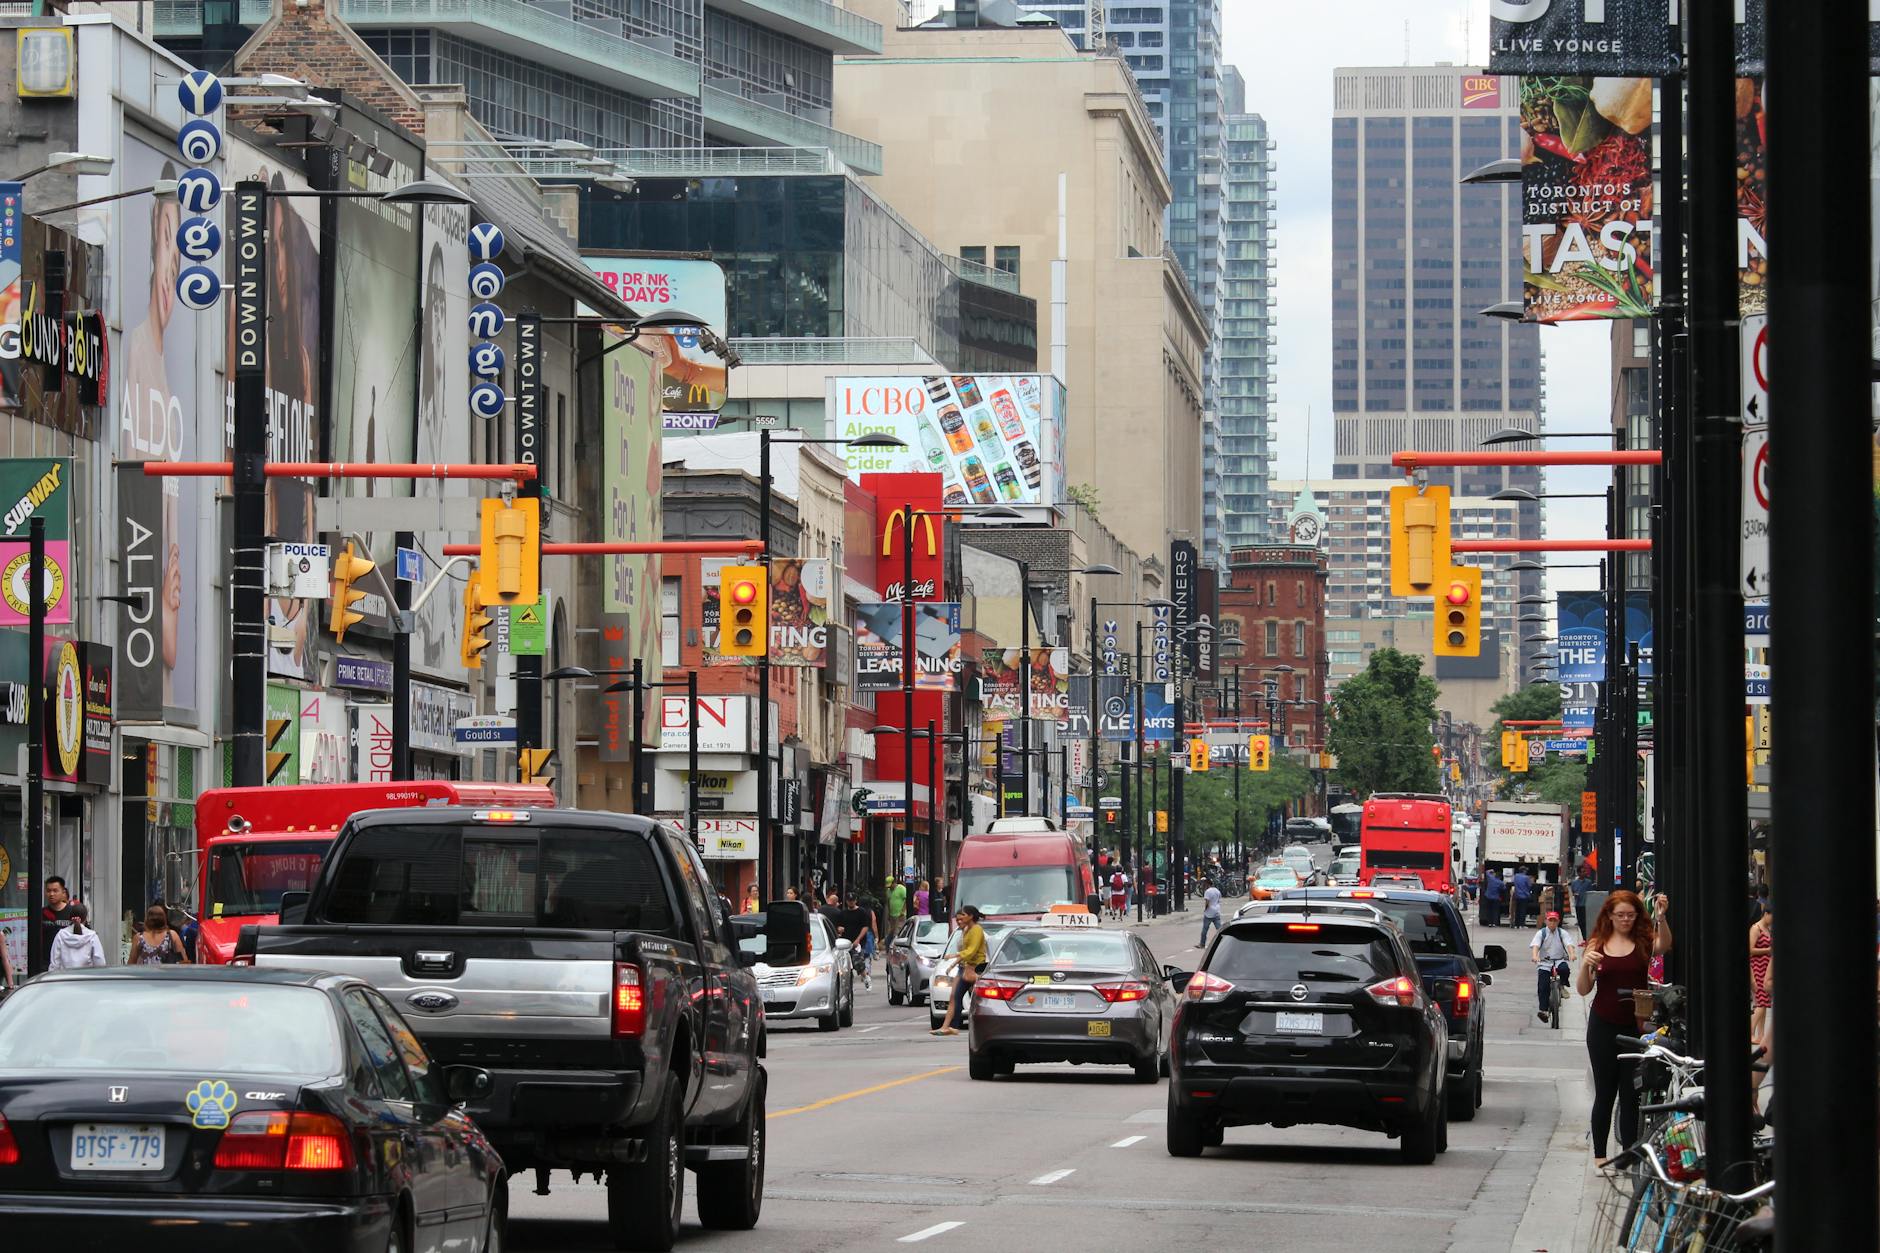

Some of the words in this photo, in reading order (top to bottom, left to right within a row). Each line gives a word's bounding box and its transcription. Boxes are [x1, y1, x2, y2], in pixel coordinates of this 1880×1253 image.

[1500, 40, 1542, 51] LIVE
[1554, 40, 1622, 52] YONGE
[1465, 78, 1496, 91] CIBC
[175, 69, 222, 310] Yonge
[1528, 184, 1631, 199] TORONTO'S
[1529, 200, 1612, 215] DISTRICT
[1620, 200, 1641, 211] OF
[241, 195, 257, 366] DOWNTOWN
[623, 273, 669, 285] DRINK
[623, 287, 670, 303] DAYS
[1530, 294, 1560, 305] LIVE
[1567, 294, 1614, 304] YONGE
[468, 223, 504, 418] Yonge
[522, 325, 534, 463] DOWNTOWN
[613, 359, 635, 425] Drop
[845, 387, 925, 416] LCBO
[122, 379, 183, 463] ALDO
[845, 422, 896, 441] Along
[845, 456, 892, 470] Cider
[4, 463, 61, 535] SUBWAY
[284, 545, 326, 557] POLICE
[126, 516, 154, 668] ALDO
[1176, 550, 1187, 643] WINNERS
[1559, 648, 1596, 664] THE
[338, 664, 355, 680] PRIME
[357, 666, 375, 682] RETAIL
[857, 657, 961, 673] LEARNING
[1143, 718, 1175, 728] ARTS
[465, 730, 491, 740] Gould
[1212, 746, 1250, 757] STYL
[721, 840, 742, 849] Nikon
[1058, 915, 1089, 925] TAXI
[245, 1091, 286, 1100] CIVIC
[75, 1135, 118, 1159] BTSF
[130, 1136, 161, 1159] 779
